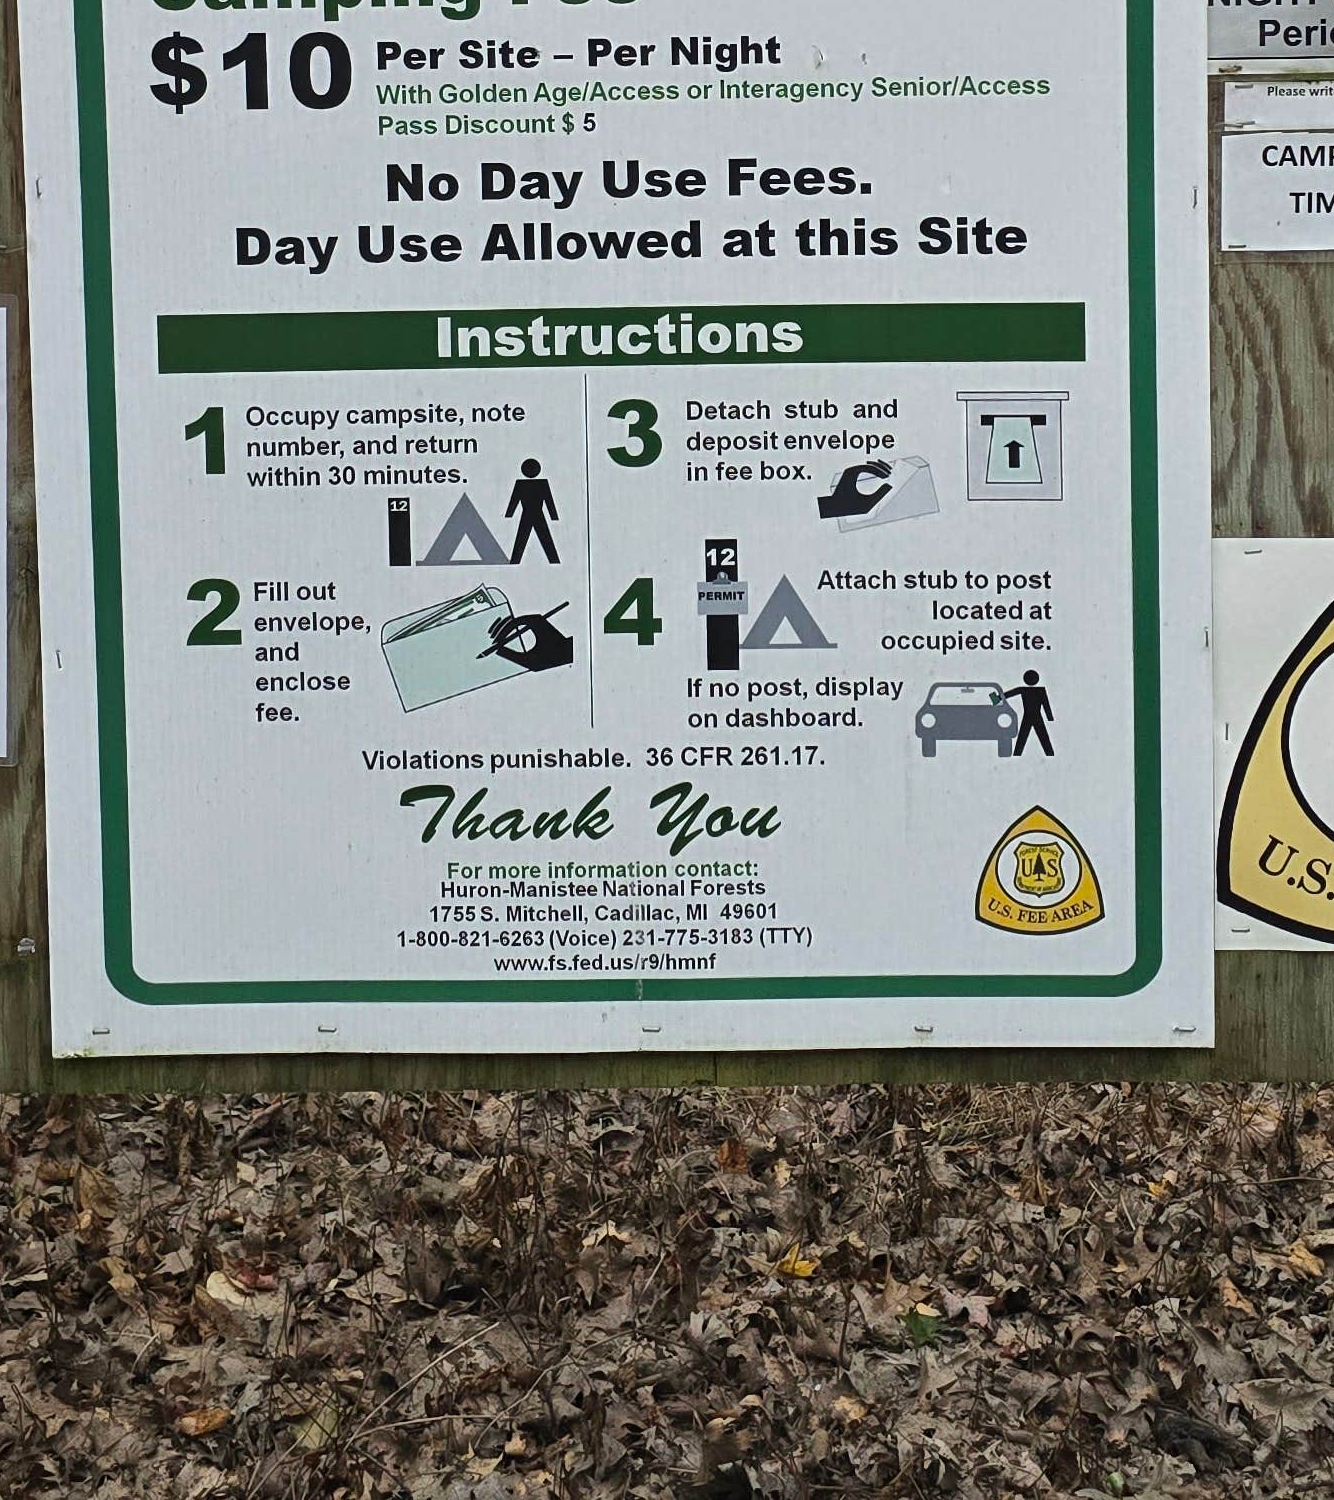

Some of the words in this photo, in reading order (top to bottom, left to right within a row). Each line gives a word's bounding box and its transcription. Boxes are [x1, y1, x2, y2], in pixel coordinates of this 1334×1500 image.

[148, 31, 352, 114] $10
[377, 81, 430, 105] With
[438, 79, 528, 103] Golden
[534, 78, 679, 107] Age/Access
[687, 82, 712, 100] or
[719, 74, 862, 103] Interagency
[870, 71, 1050, 98] Senior/Access
[1267, 85, 1306, 96] Please
[436, 314, 804, 359] Instructions
[246, 406, 339, 430] Occupy
[346, 403, 465, 427] campsite,
[471, 404, 525, 423] note
[185, 406, 225, 474] 1
[390, 500, 408, 511] 12
[698, 590, 744, 602] PERMIT
[362, 750, 484, 771] Violations
[490, 748, 631, 773] punishable.
[646, 747, 673, 767] 36
[681, 747, 733, 767] CFR
[740, 746, 826, 767] 261.17.
[399, 785, 615, 843] Thank
[649, 781, 781, 857] You
[1258, 835, 1334, 900] U.S.
[441, 881, 598, 898] Huron-Manistee
[603, 880, 685, 897] National
[690, 879, 765, 896] Forests
[397, 930, 544, 948] 1-800-821-6263
[549, 929, 617, 950] (Voice)
[622, 928, 753, 946] 231-775-3183
[759, 927, 813, 947] (TTY)
[494, 953, 716, 972] www.fs.fed.us/r9/hmnf
